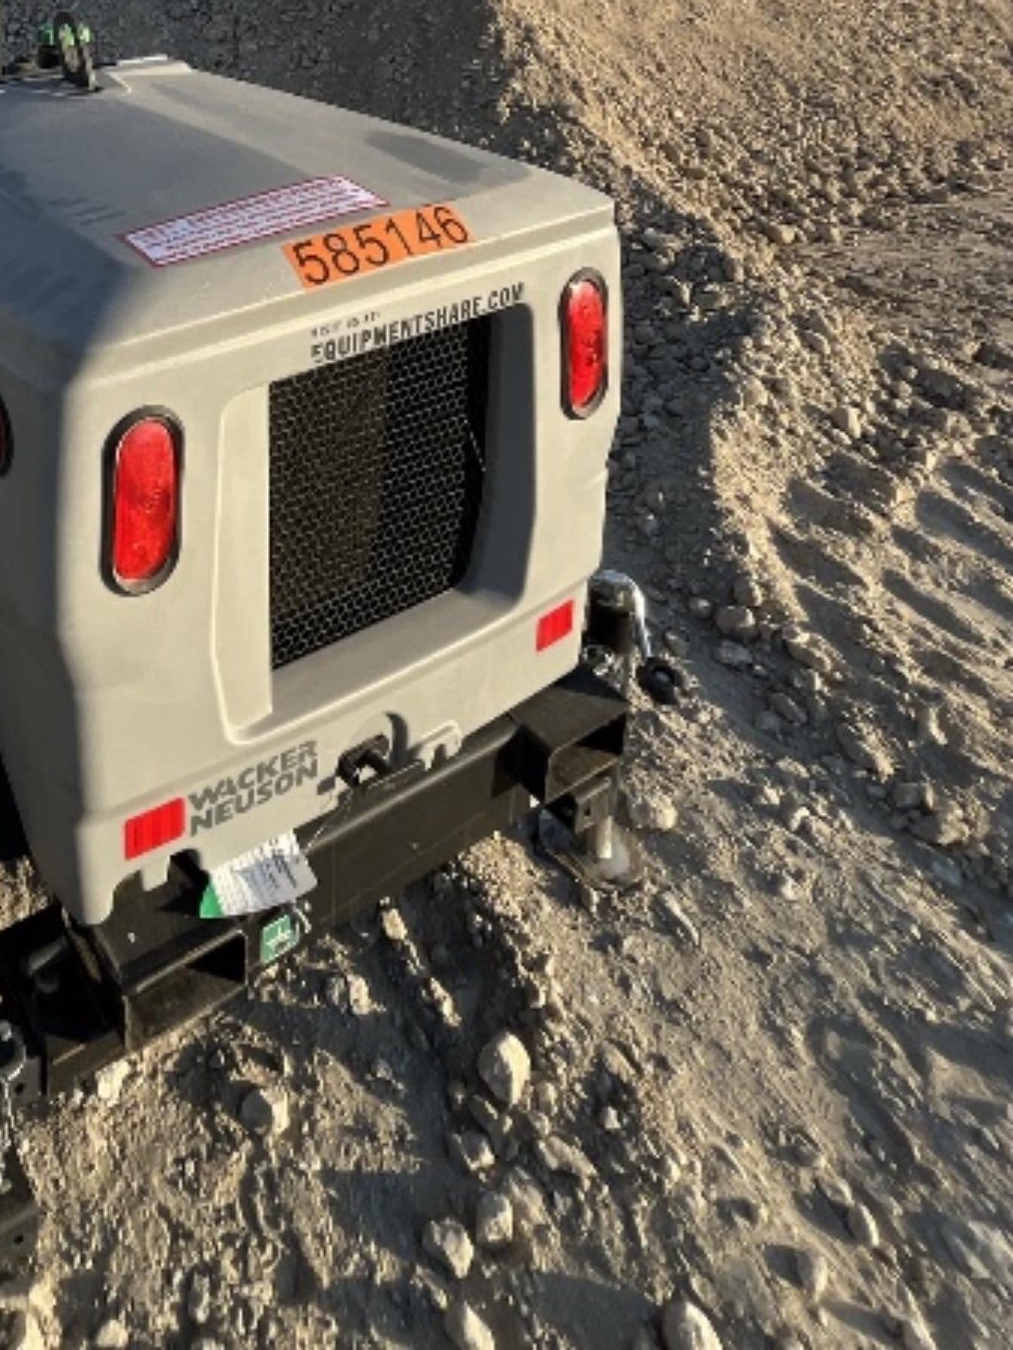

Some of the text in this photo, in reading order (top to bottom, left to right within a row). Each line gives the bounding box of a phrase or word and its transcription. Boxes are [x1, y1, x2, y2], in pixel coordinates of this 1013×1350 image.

[292, 206, 469, 285] 585146
[310, 281, 525, 364] EQUIPMENTSHARE.COM
[188, 740, 318, 811] WACKER
[190, 758, 318, 838] NEUSON
